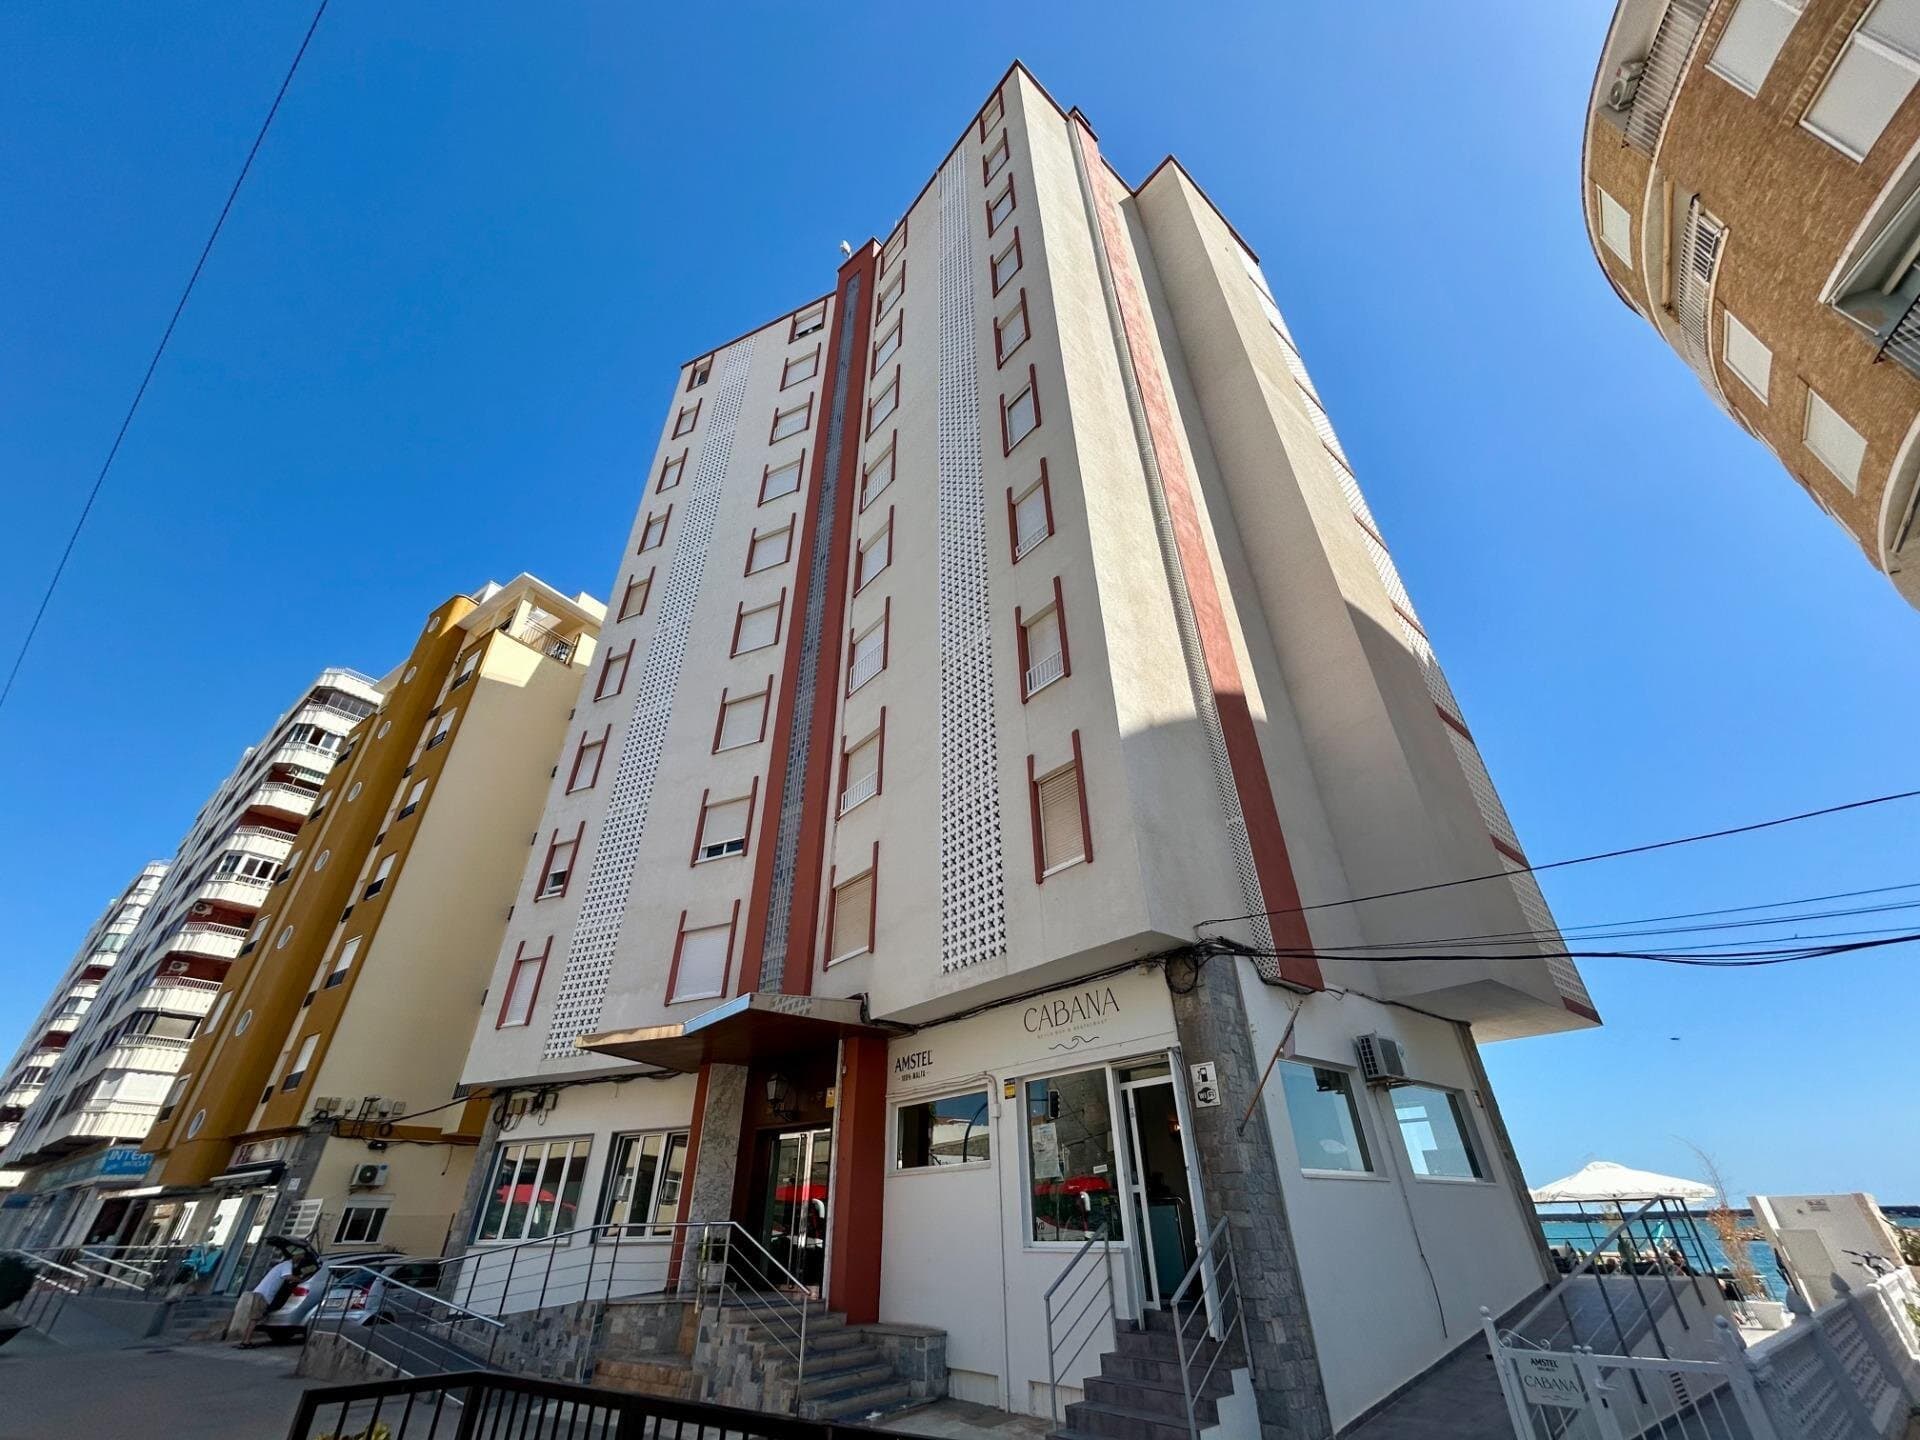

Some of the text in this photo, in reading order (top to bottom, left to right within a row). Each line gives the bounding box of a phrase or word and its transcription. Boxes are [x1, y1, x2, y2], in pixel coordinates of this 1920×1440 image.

[1023, 987, 1120, 1033] CABANA
[894, 1050, 934, 1073] AMSTEL
[1530, 1358, 1559, 1369] AMSTEL
[1524, 1375, 1579, 1394] CABANA
